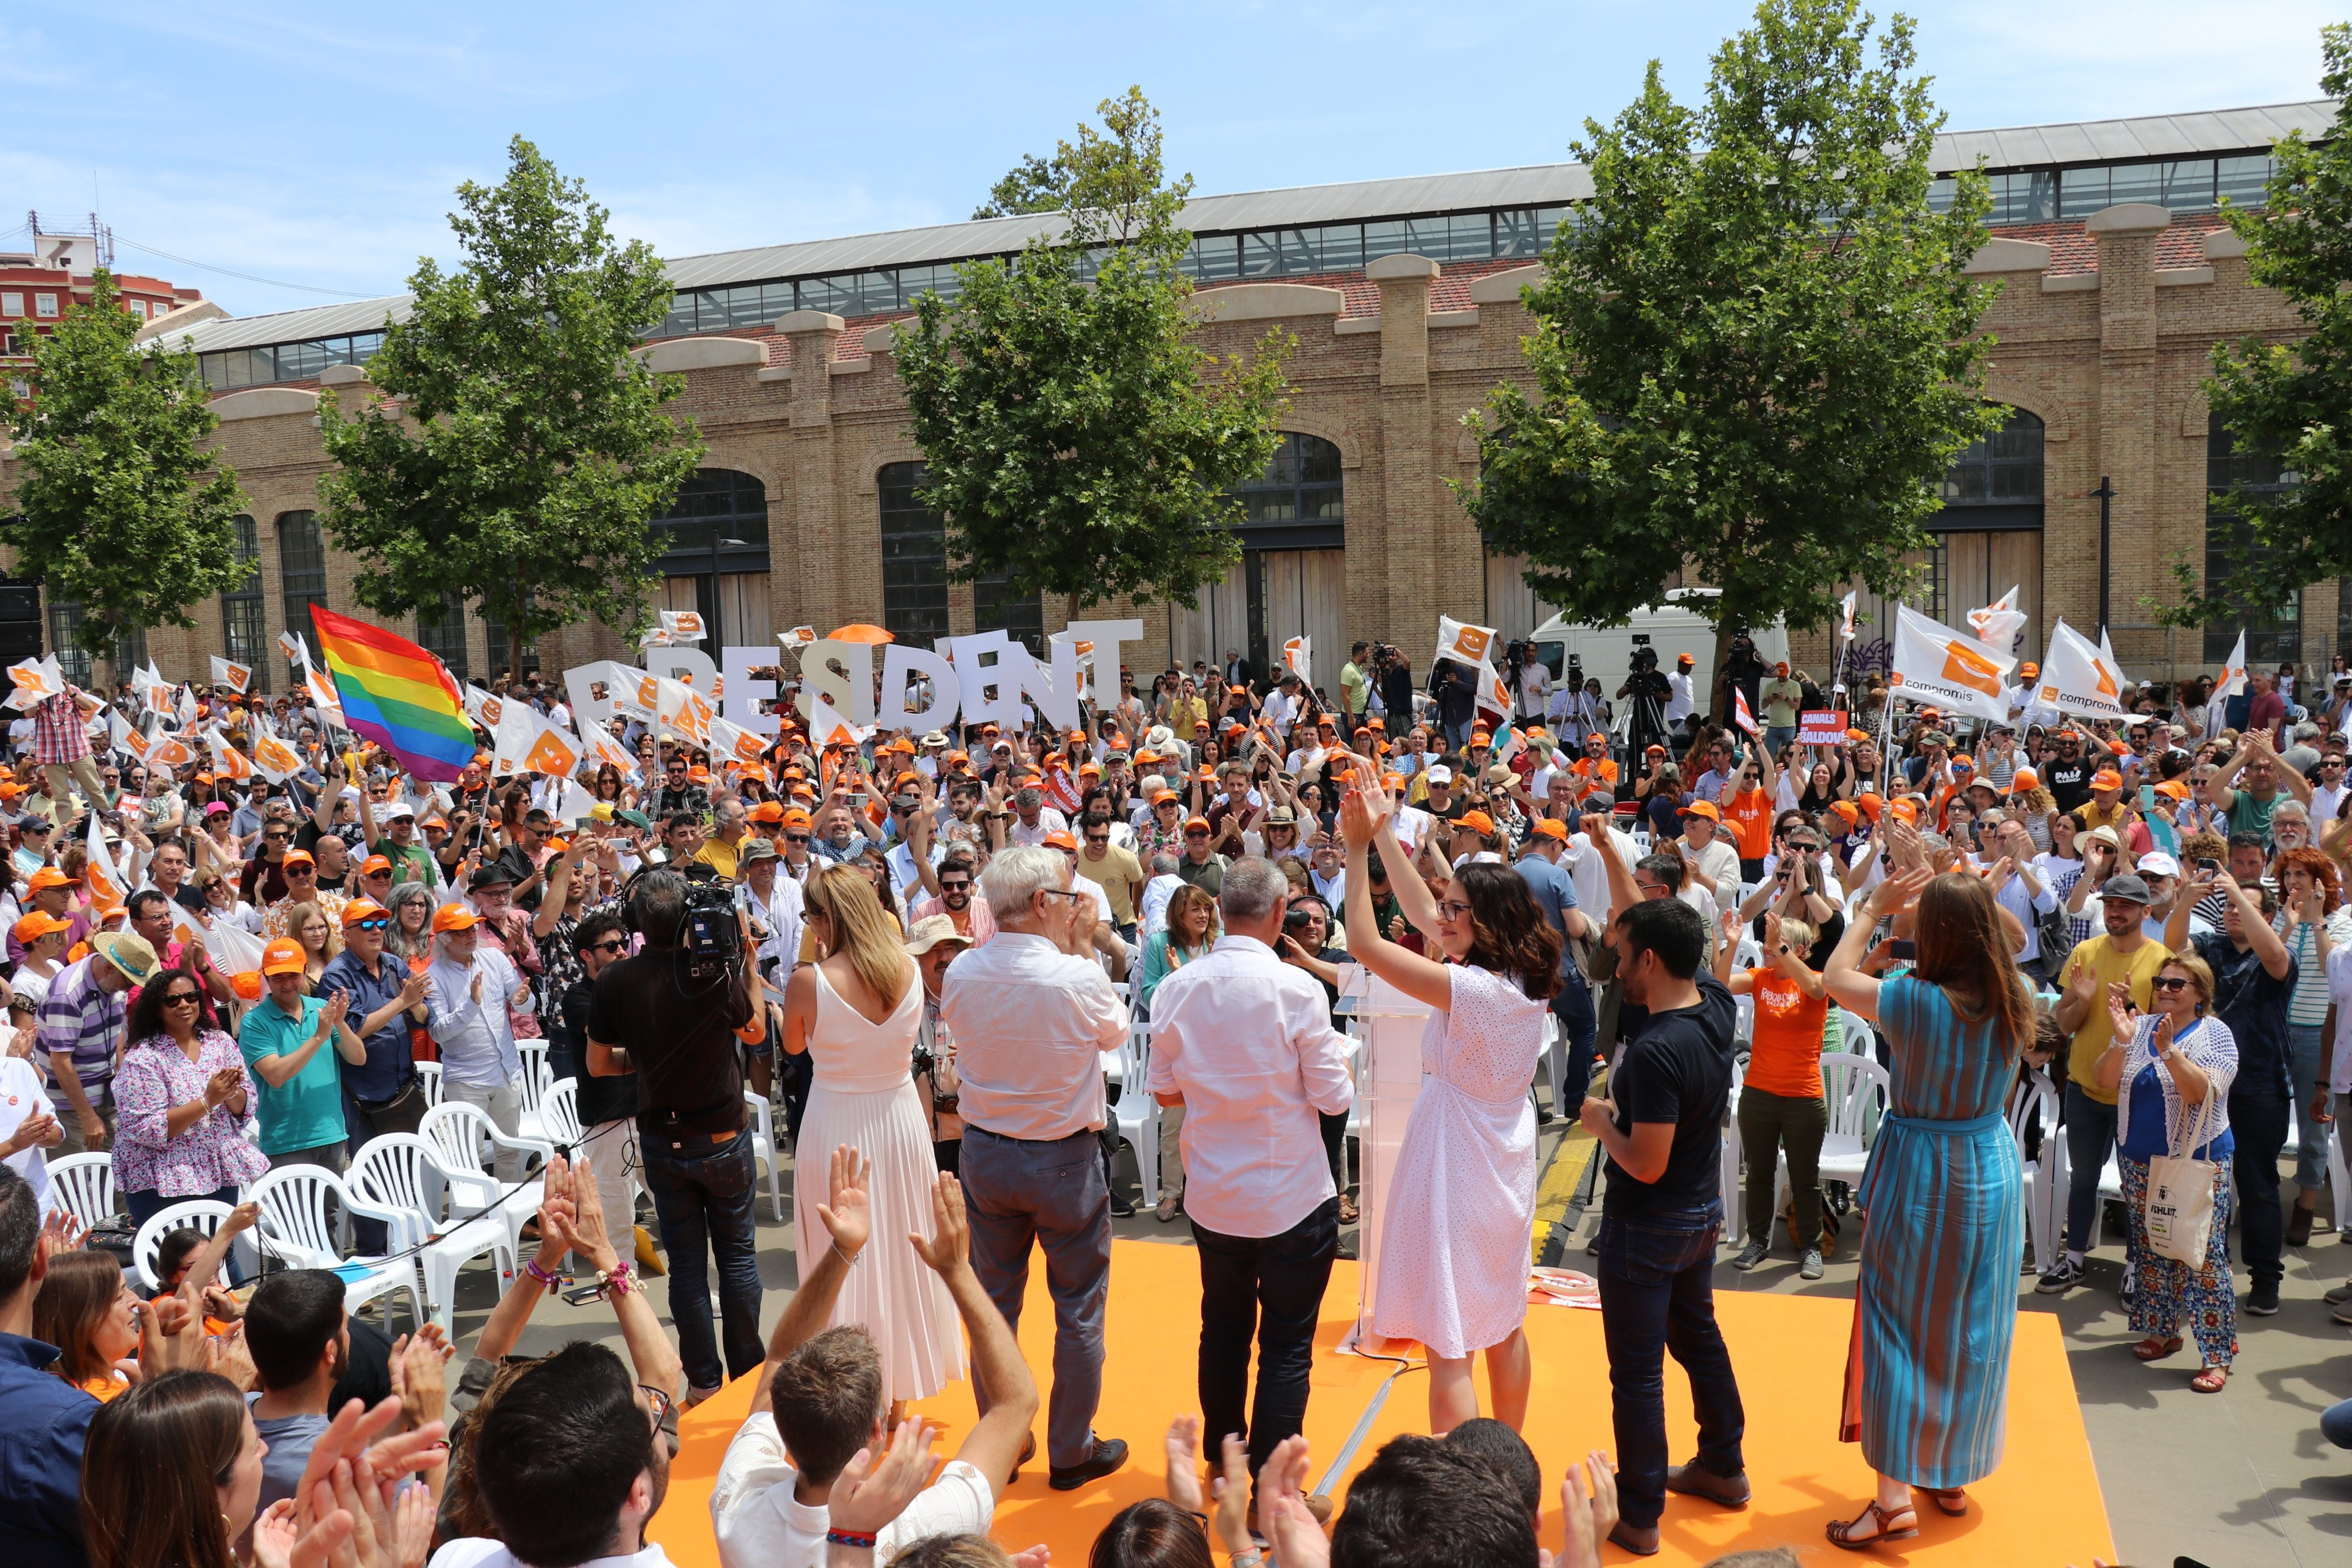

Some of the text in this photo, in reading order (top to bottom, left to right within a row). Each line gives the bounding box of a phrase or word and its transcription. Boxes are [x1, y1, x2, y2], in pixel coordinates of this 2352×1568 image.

[1802, 714, 1836, 725] CANALS
[1800, 729, 1845, 744] BALDOVÍ
[2150, 1205, 2176, 1217] ISHLIST
